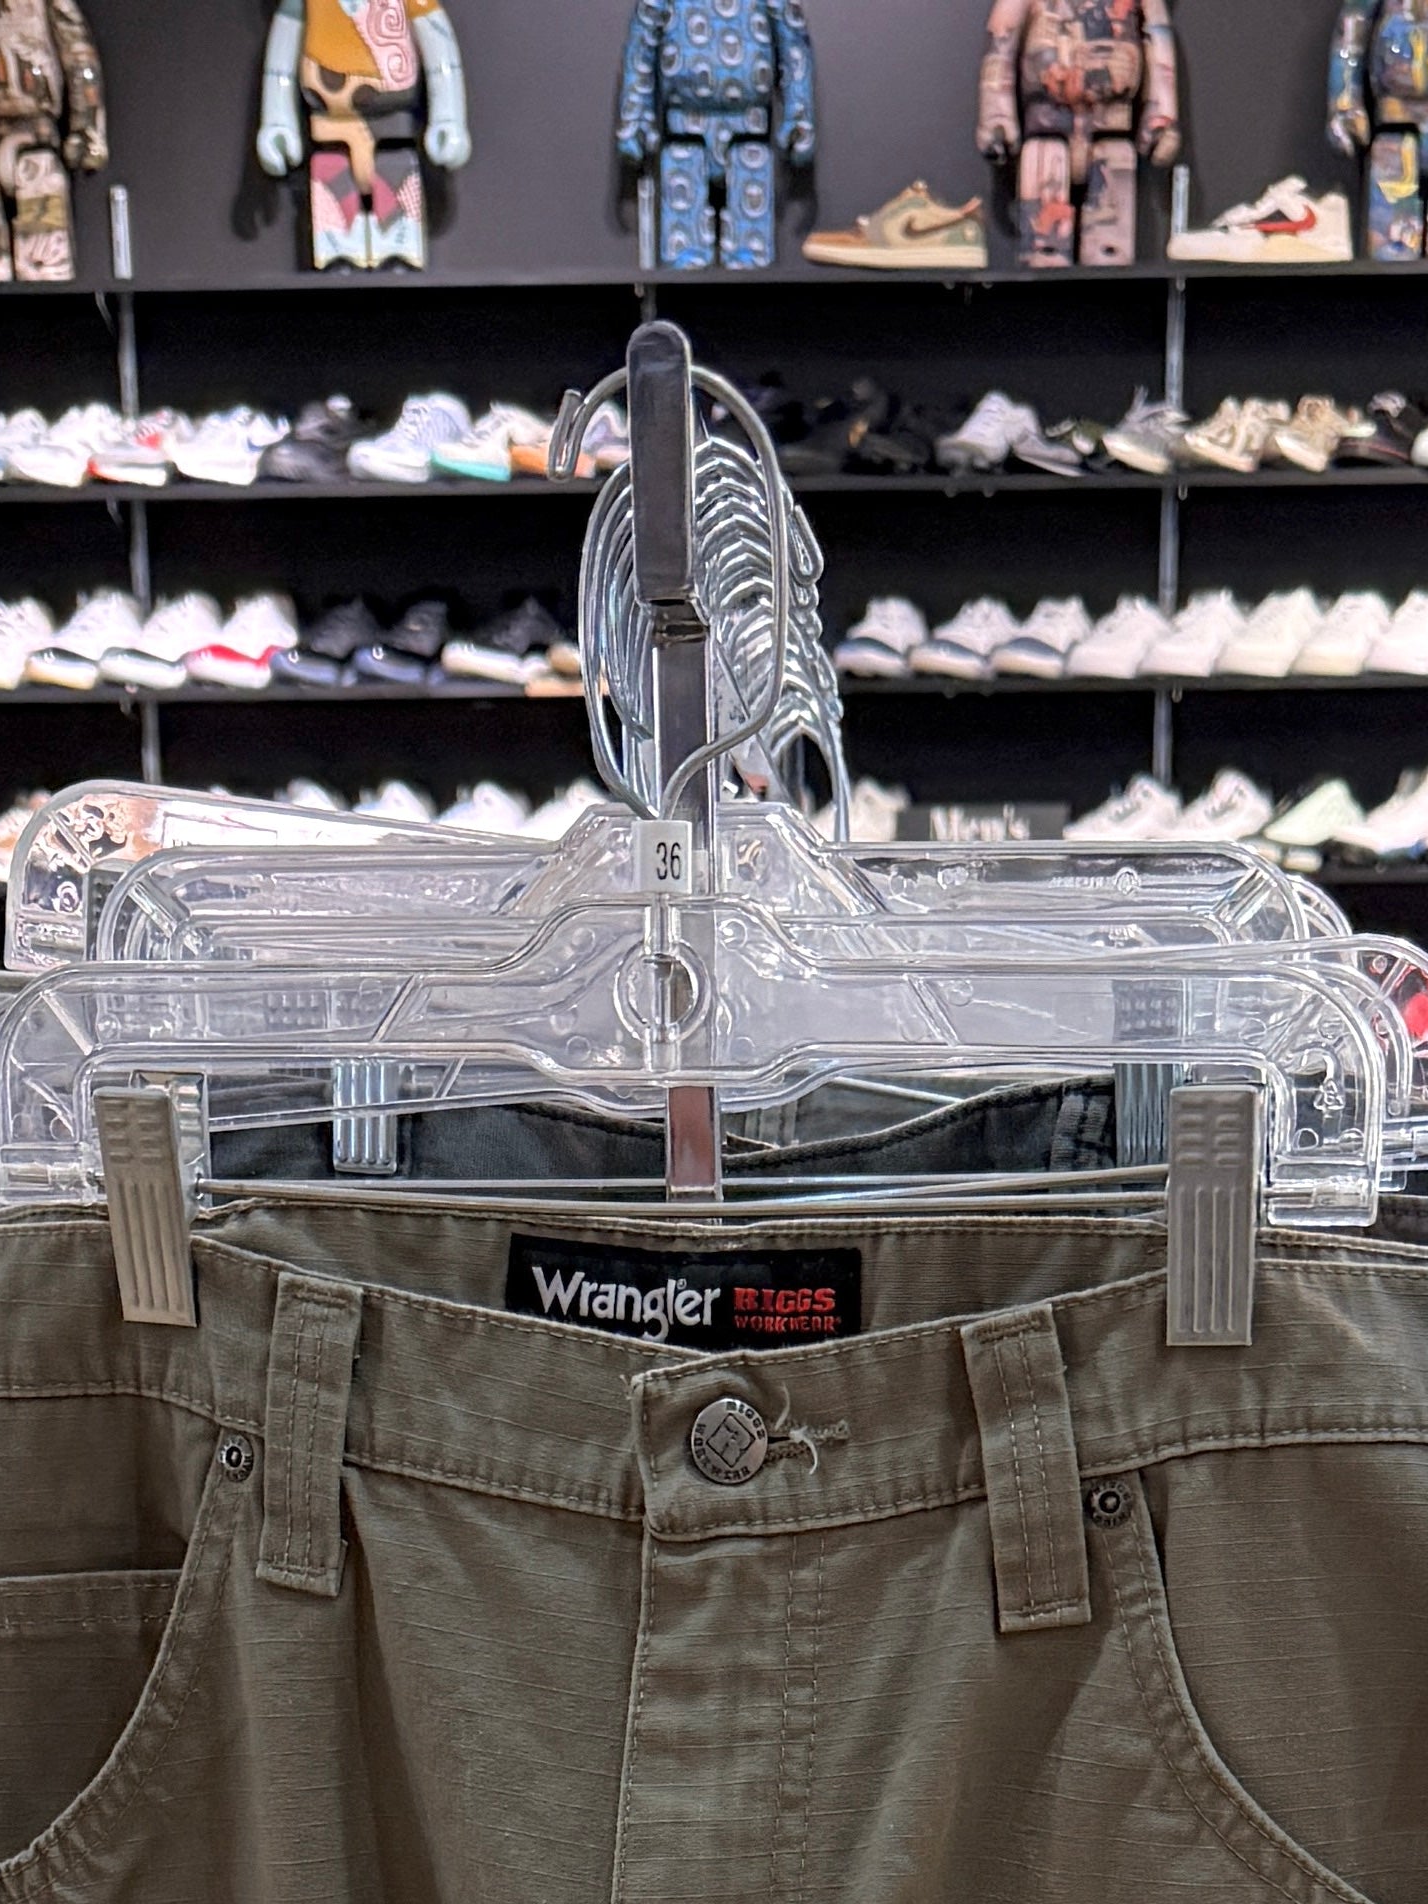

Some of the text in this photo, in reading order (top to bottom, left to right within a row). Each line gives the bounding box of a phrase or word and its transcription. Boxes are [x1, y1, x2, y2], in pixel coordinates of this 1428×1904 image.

[656, 842, 681, 880] 36
[532, 1266, 836, 1342] Wrangler RIGGS
[734, 1315, 837, 1333] WORKWEAR
